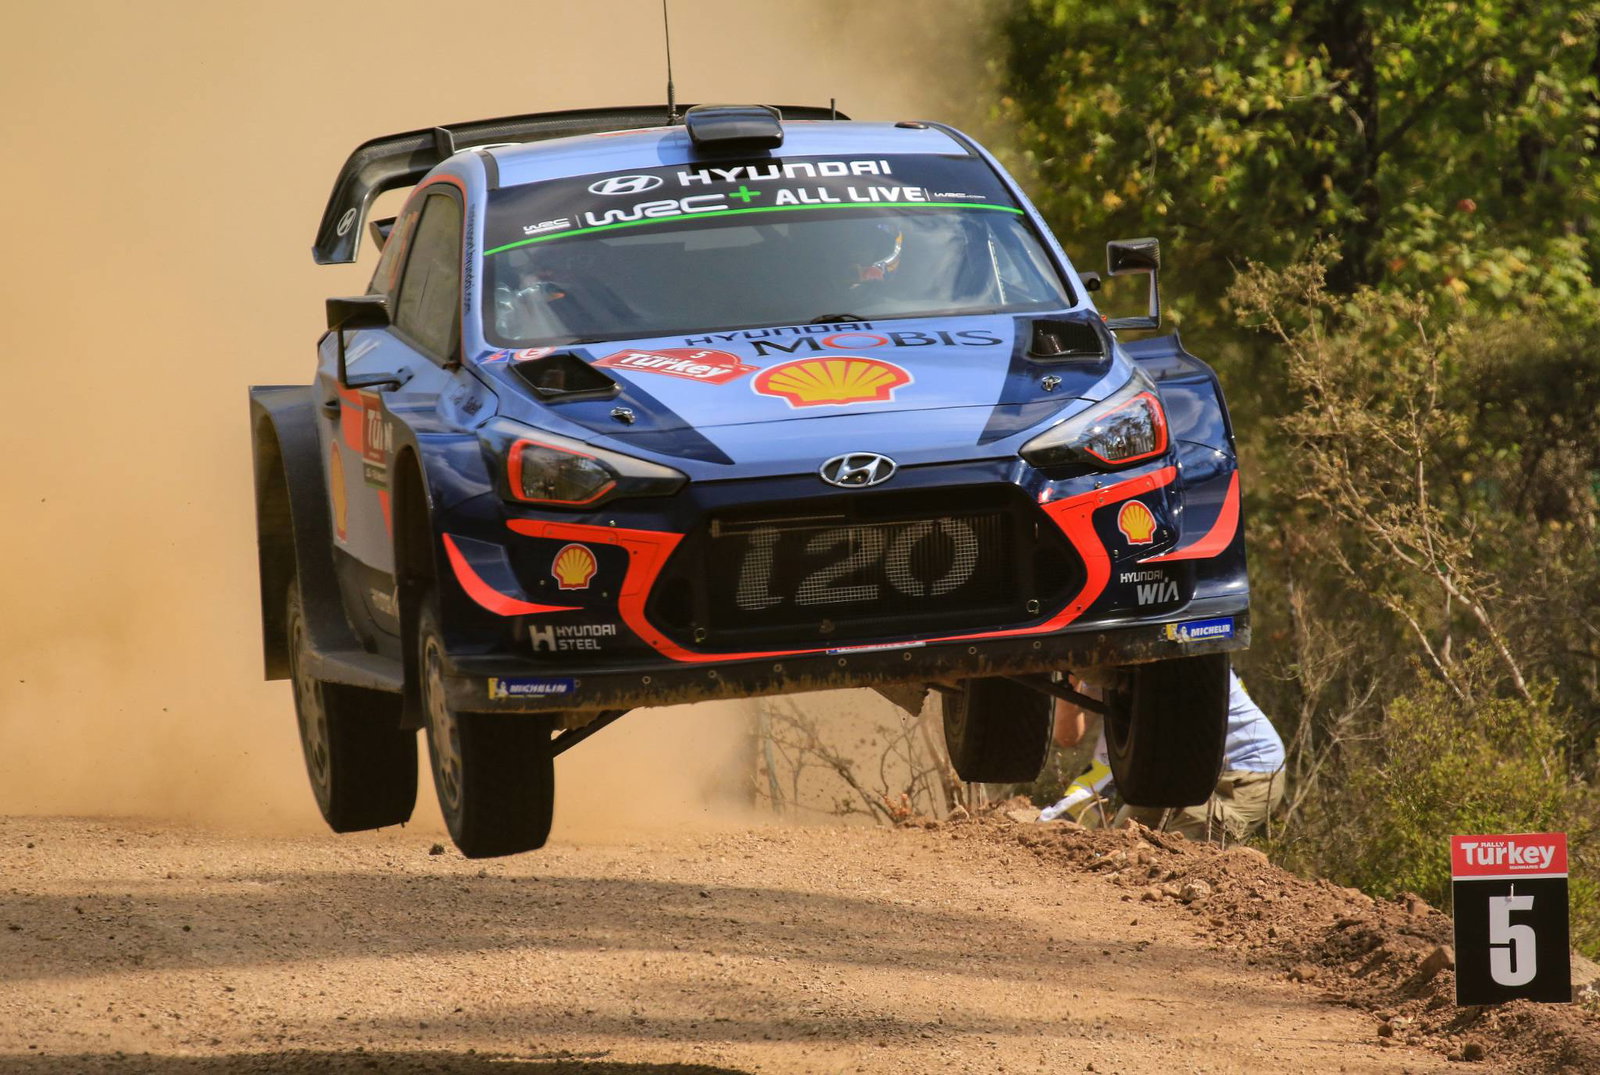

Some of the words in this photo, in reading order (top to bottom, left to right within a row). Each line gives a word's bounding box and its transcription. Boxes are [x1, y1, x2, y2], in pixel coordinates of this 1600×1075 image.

[677, 160, 892, 187] HYUNDAI
[775, 186, 841, 206] ALL
[847, 186, 926, 202] LIVE
[684, 322, 874, 346] HYUNDAI
[750, 330, 1003, 357] MOBIS
[620, 353, 732, 378] Turkey
[1120, 570, 1164, 583] HYUNDAI
[1136, 577, 1179, 605] WIA
[555, 624, 617, 637] HYUNDAI
[1190, 624, 1231, 637] MICHELIN
[558, 638, 601, 650] STEEL
[509, 684, 567, 694] MICHELIN
[1461, 841, 1556, 869] Turkey
[1489, 895, 1537, 986] 5
